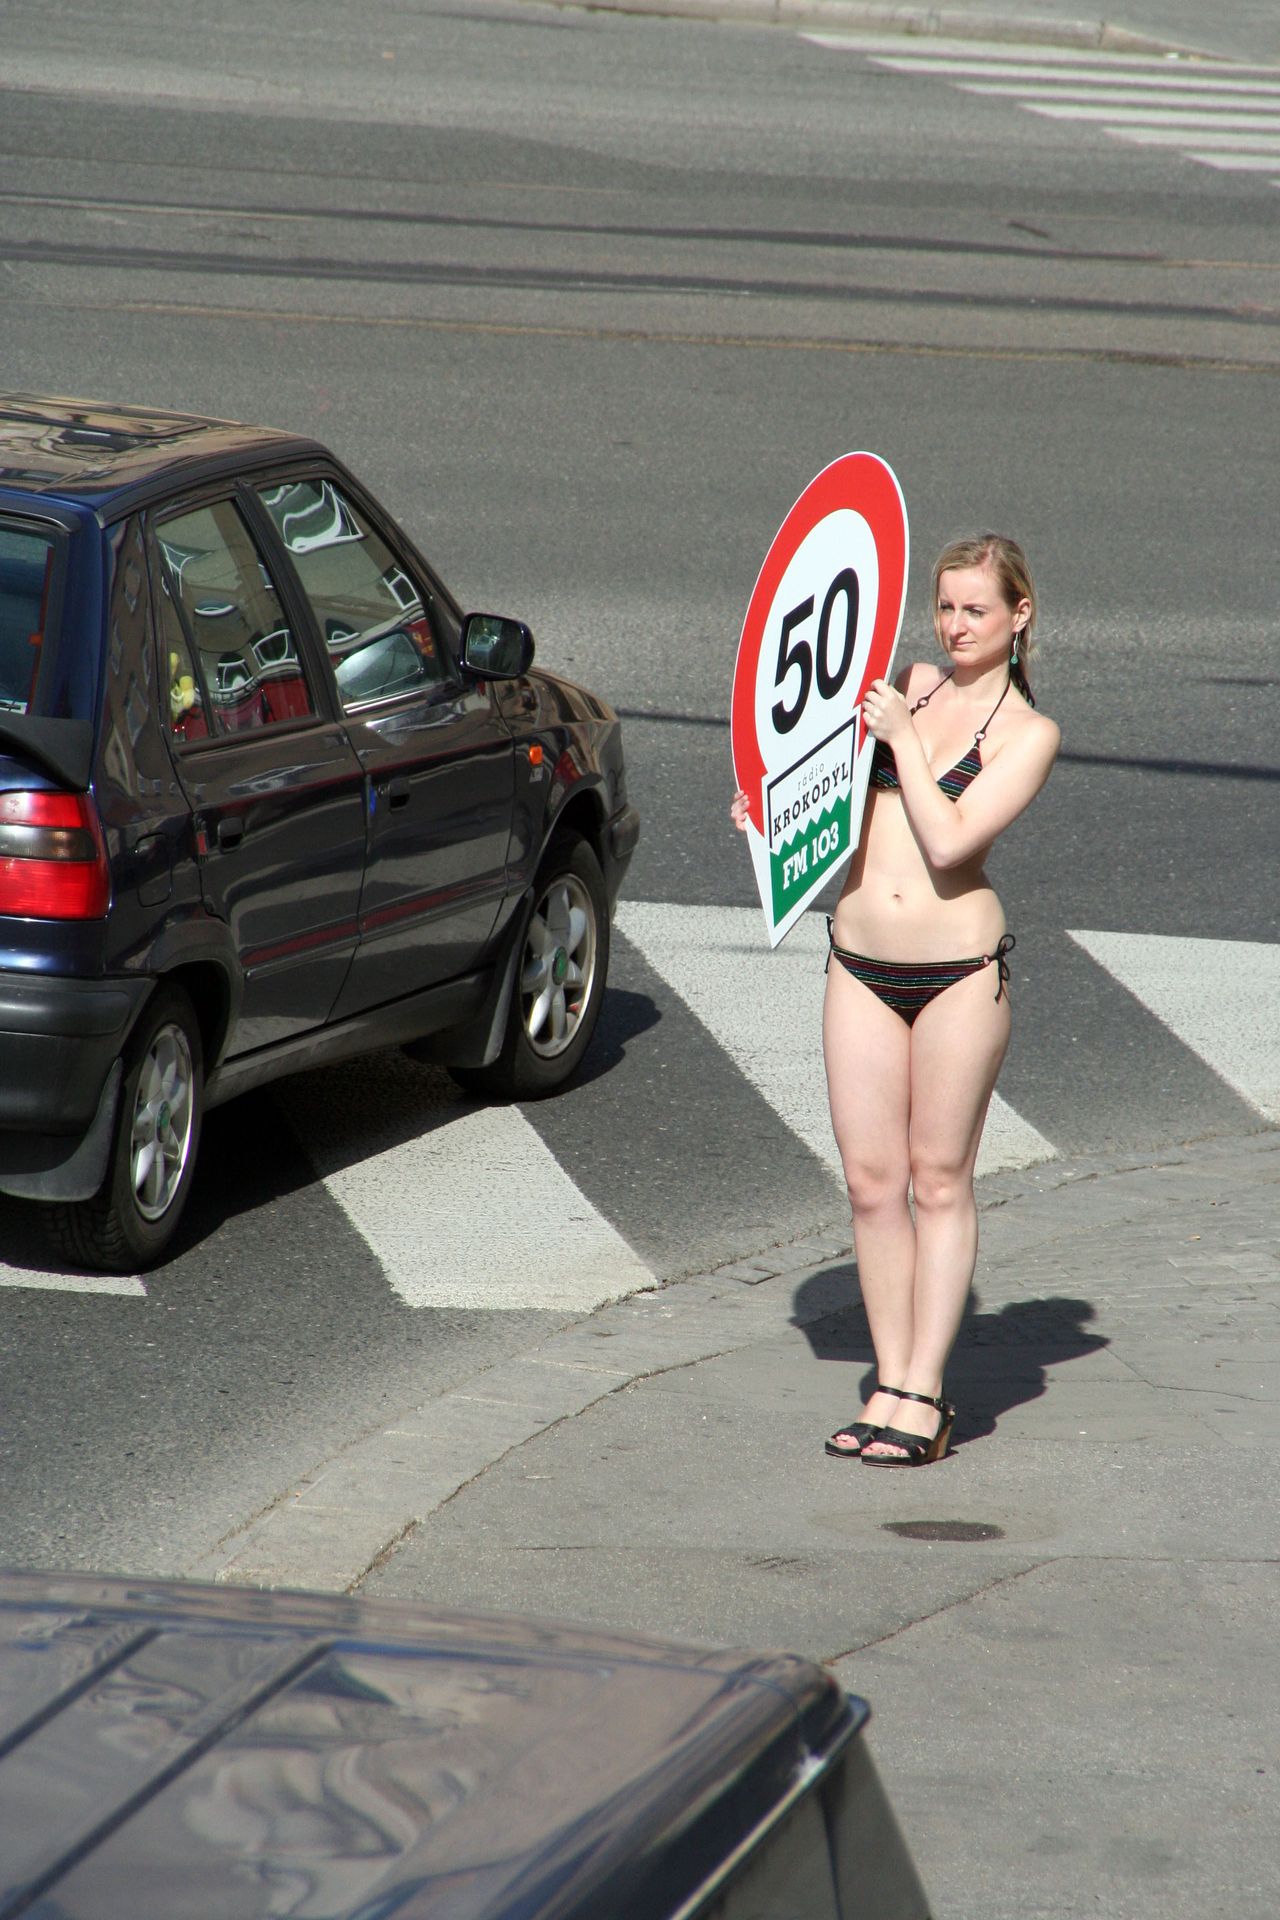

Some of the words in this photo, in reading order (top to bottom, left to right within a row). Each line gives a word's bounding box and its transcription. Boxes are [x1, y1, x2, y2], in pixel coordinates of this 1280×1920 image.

[772, 567, 860, 734] 50
[782, 845, 808, 890] FM
[812, 821, 839, 866] 103
